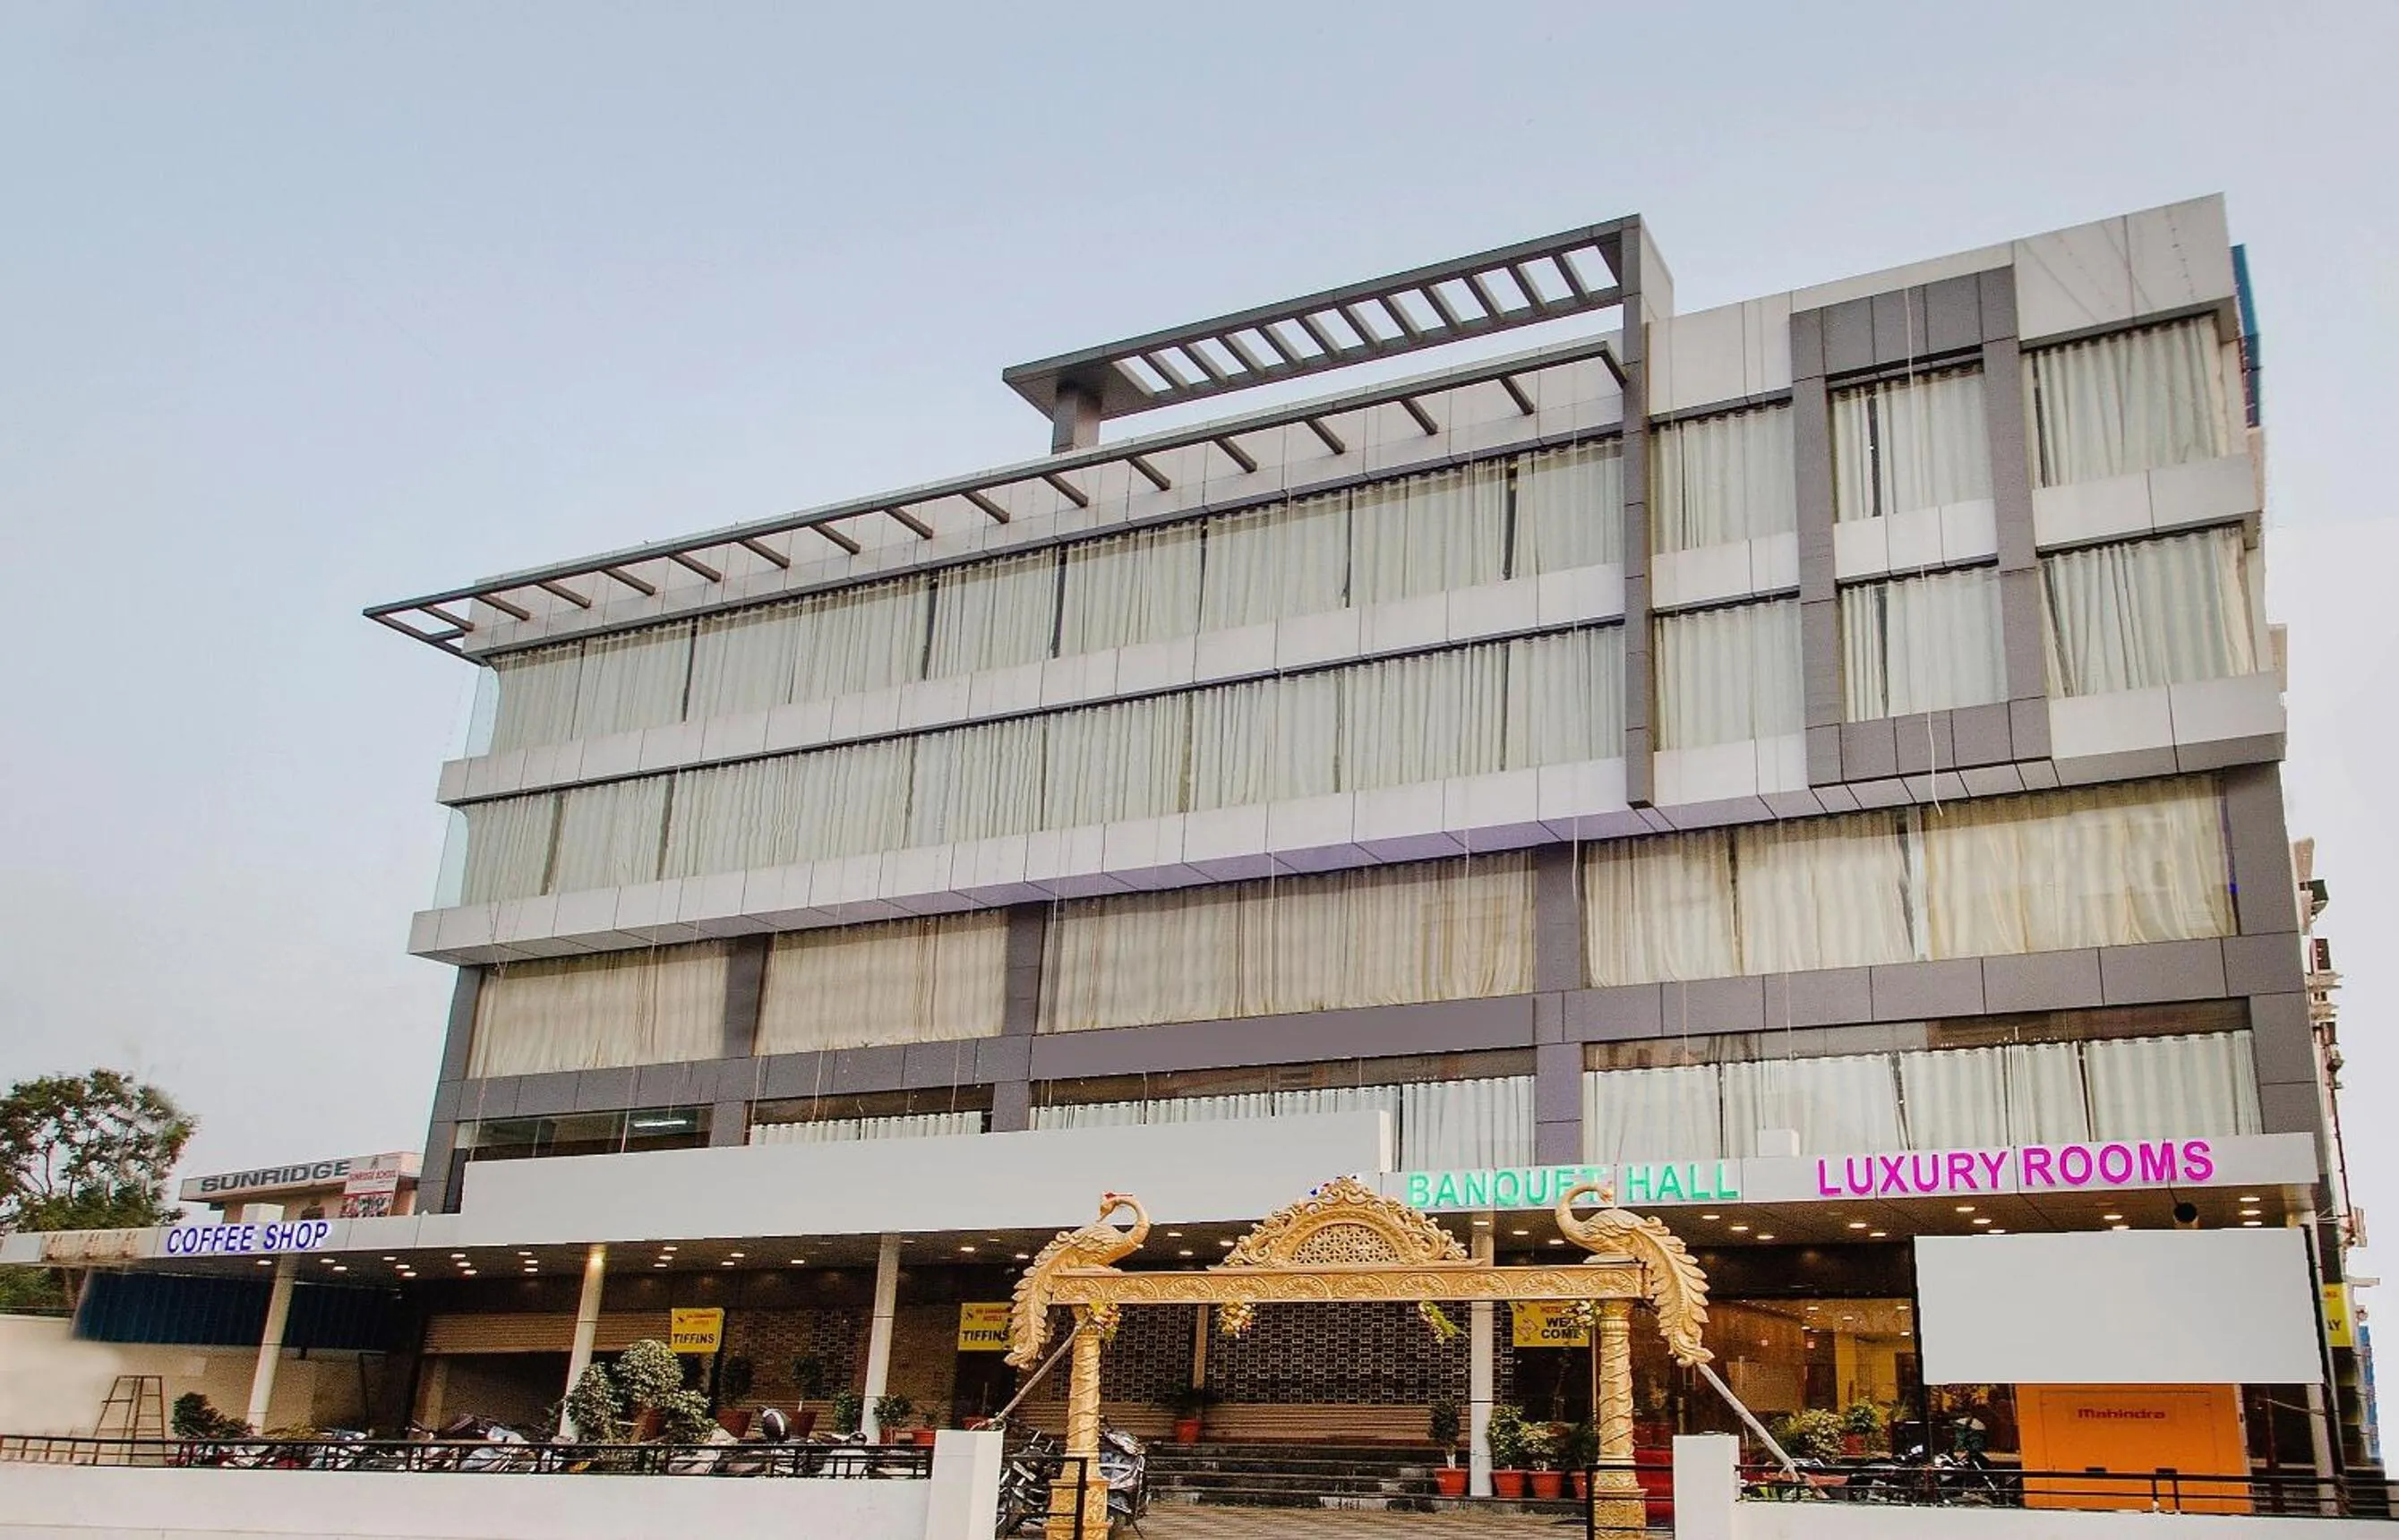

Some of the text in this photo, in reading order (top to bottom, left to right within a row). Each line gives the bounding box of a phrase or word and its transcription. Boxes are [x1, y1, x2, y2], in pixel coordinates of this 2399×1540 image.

[200, 1159, 352, 1193] SUNRIDGE
[1625, 1161, 1741, 1202] HALL
[1816, 1140, 2215, 1197] LUXURY ROOMS
[167, 1220, 329, 1253] COFFEE SHOP
[673, 1332, 715, 1344] TIFFINS
[963, 1330, 1009, 1342] TIFFINS
[2078, 1407, 2166, 1419] Mahindra
